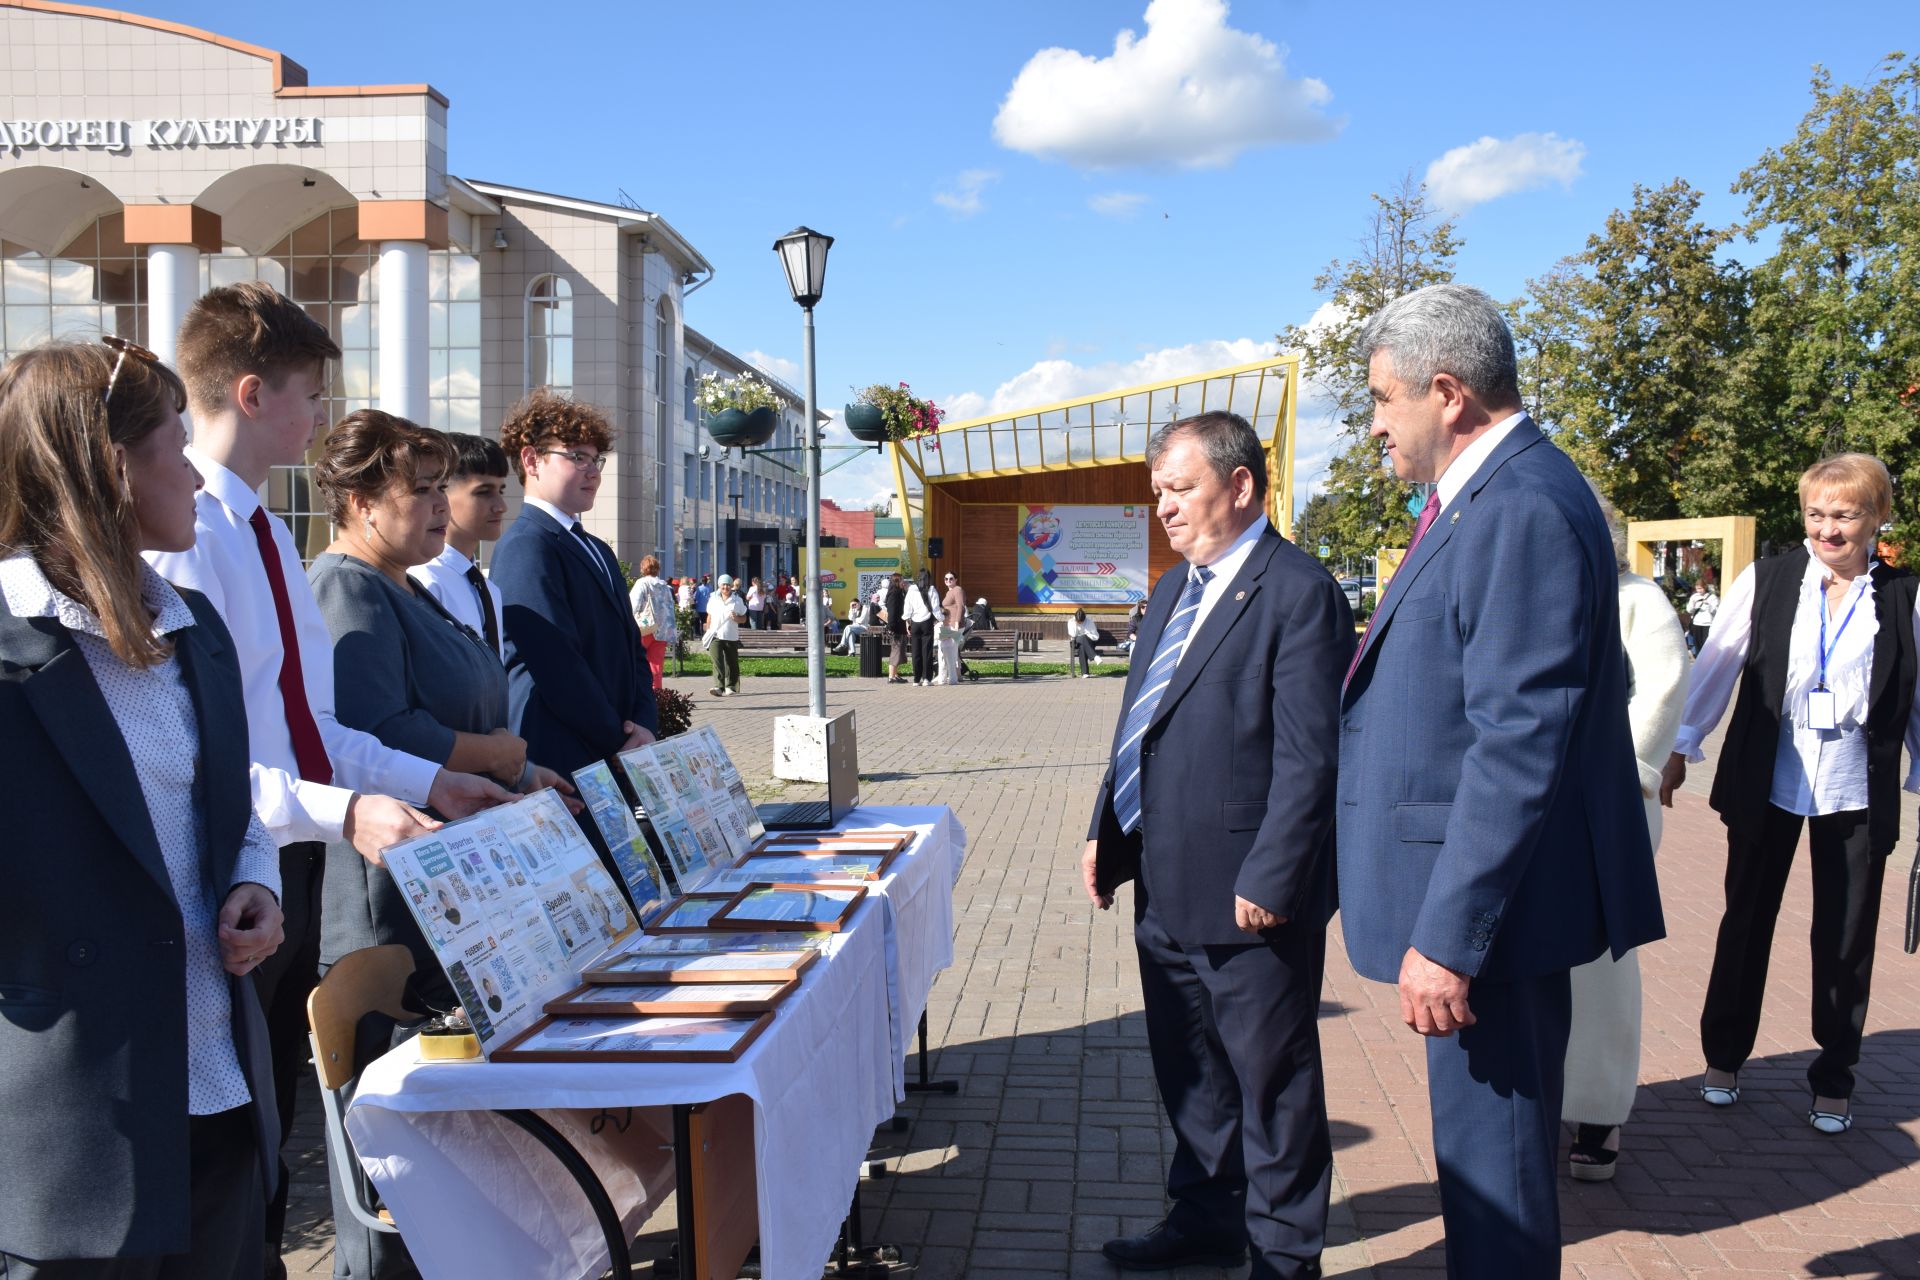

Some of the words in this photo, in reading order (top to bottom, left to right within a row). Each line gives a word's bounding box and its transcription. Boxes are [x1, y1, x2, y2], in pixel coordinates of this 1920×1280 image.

[0, 120, 125, 152] ДВОРЕЦ
[145, 117, 318, 145] КУЛЬТУРЫ
[447, 836, 474, 851] Deportes
